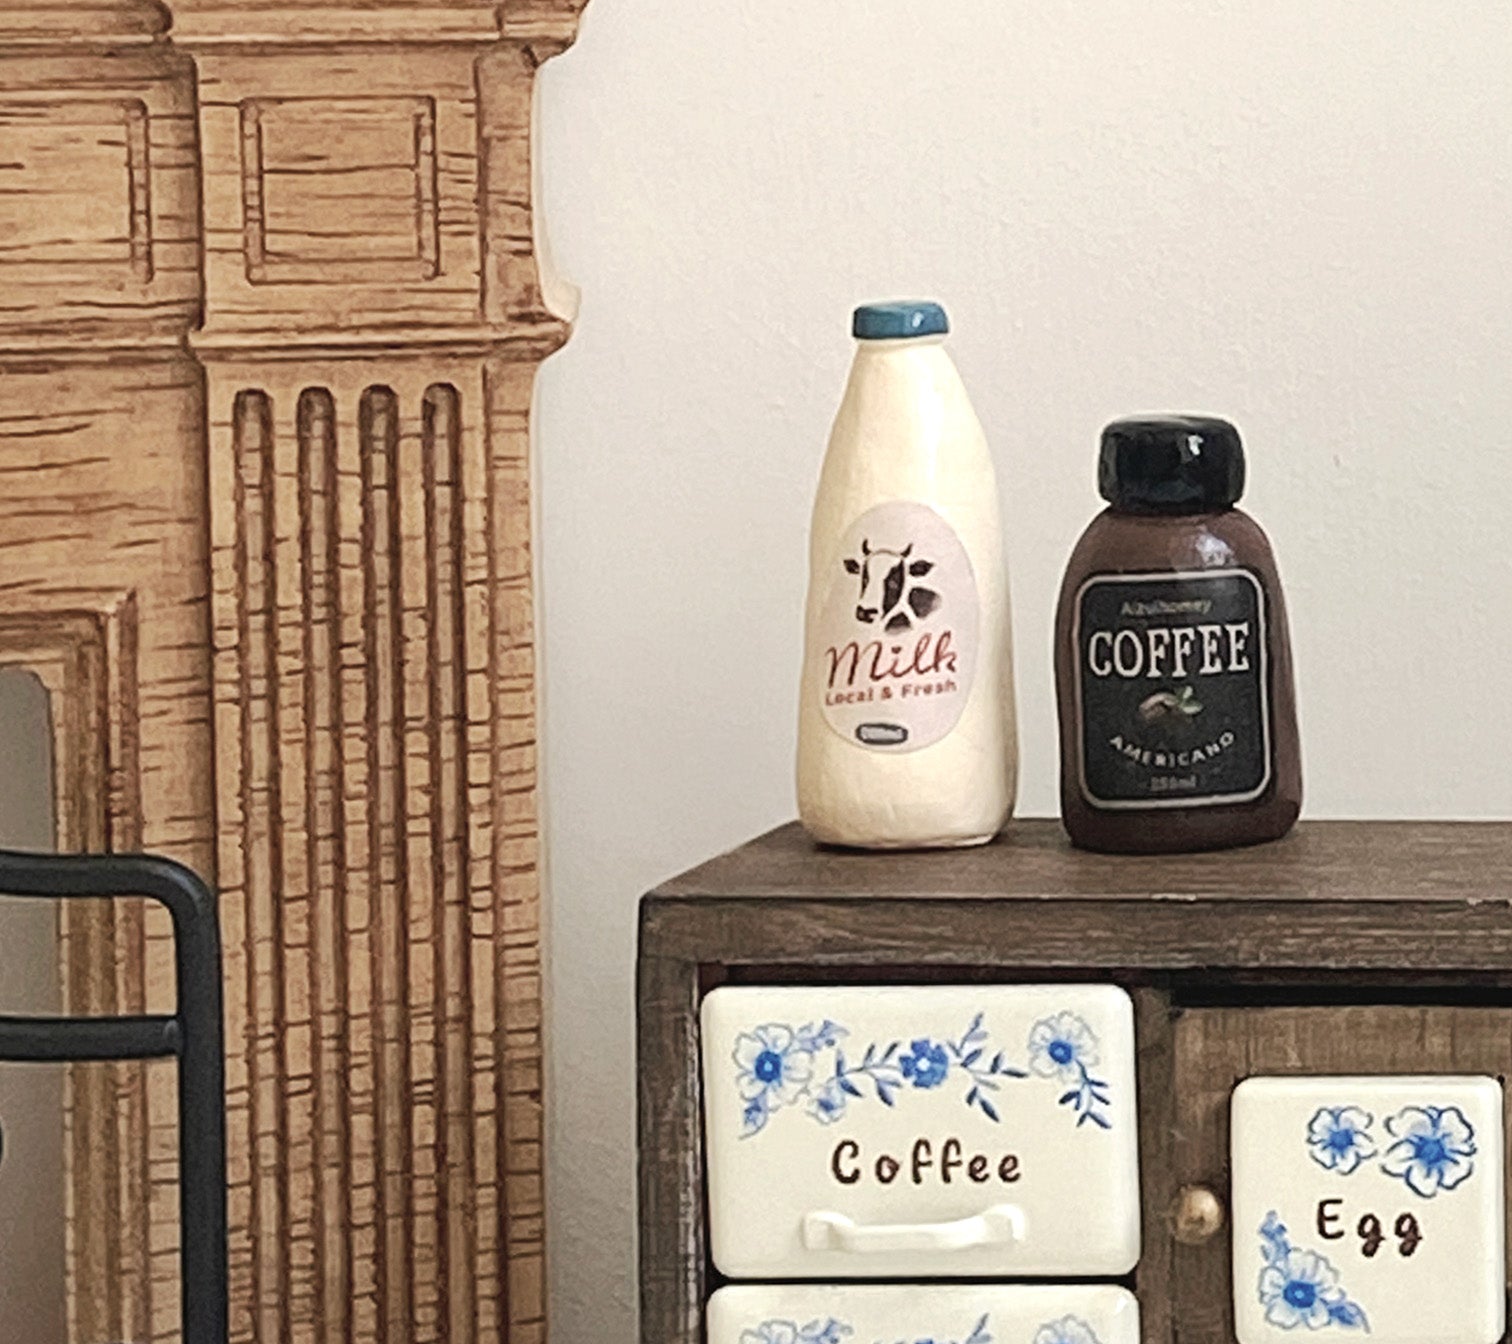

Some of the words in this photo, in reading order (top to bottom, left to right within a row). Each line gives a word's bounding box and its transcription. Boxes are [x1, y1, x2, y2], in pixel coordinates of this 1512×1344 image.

[1088, 621, 1250, 678] COFFEE
[825, 687, 874, 707] Local
[880, 686, 892, 700] &
[901, 679, 957, 698] Fresh
[1109, 731, 1236, 769] AMERICANO
[830, 1137, 1023, 1187] Coffee
[1316, 1198, 1423, 1258] Egg
